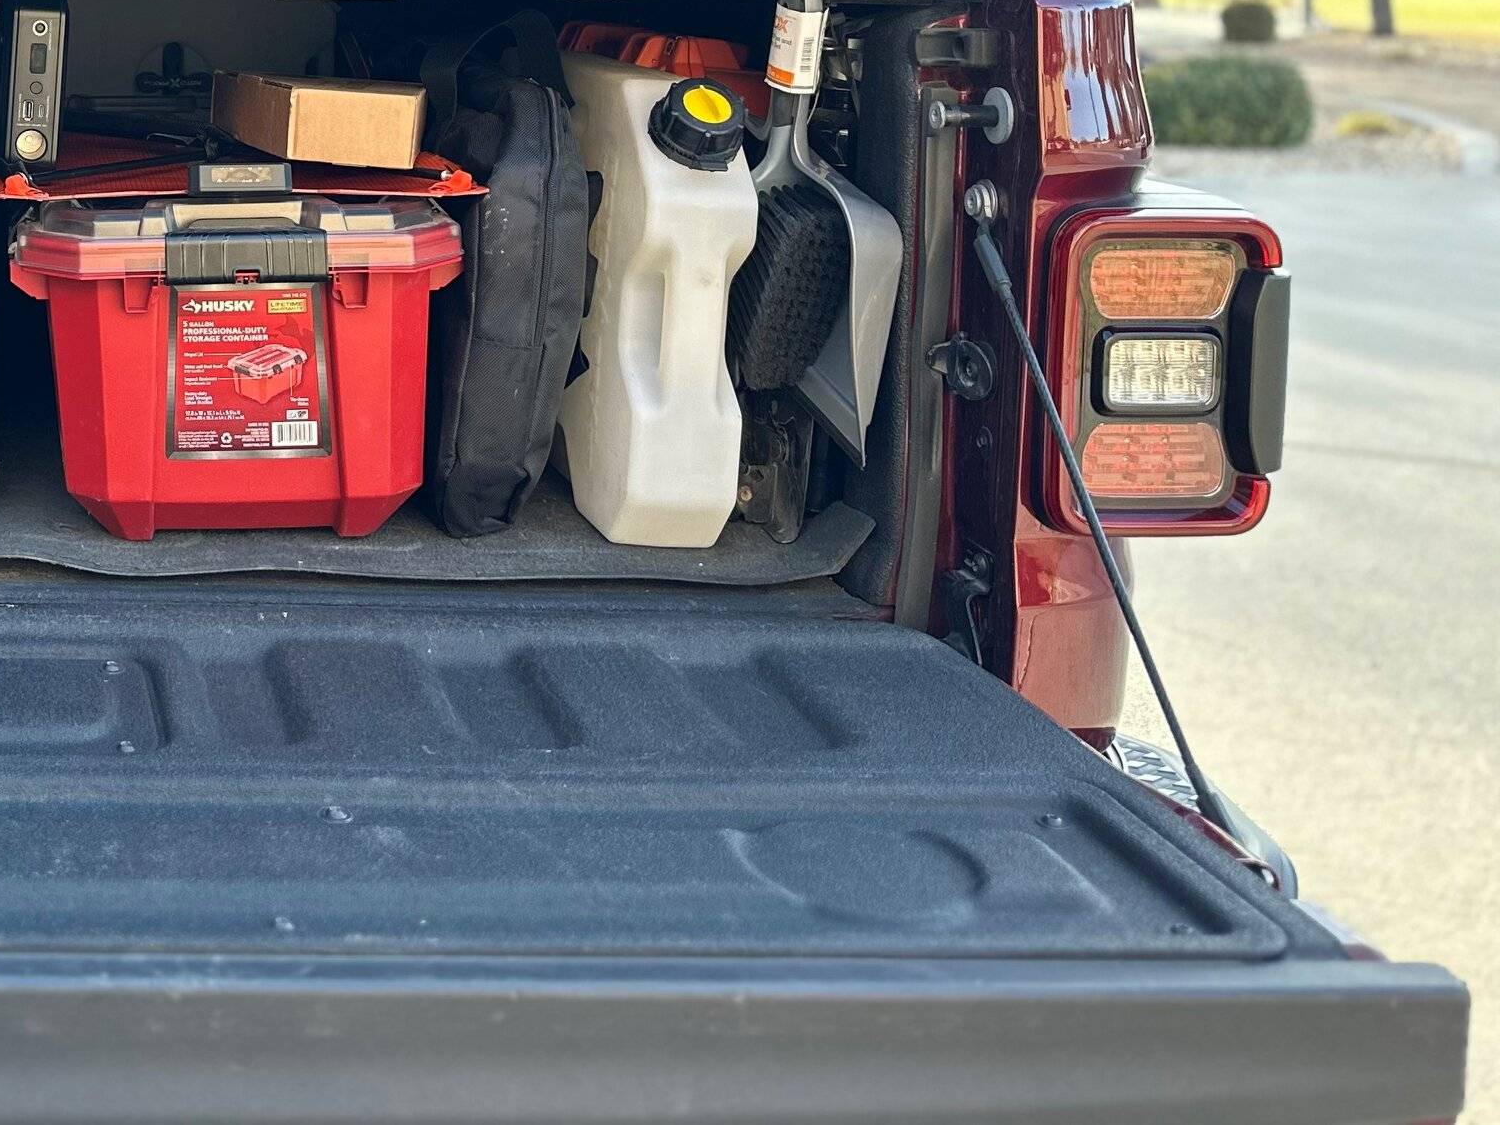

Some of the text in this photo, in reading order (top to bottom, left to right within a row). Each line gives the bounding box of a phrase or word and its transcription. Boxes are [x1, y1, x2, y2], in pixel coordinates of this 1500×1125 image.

[201, 300, 255, 313] HUSKY
[182, 327, 267, 335] PROFESSIONAL-DUTY
[183, 334, 269, 343] STORAGE CONTAINER
